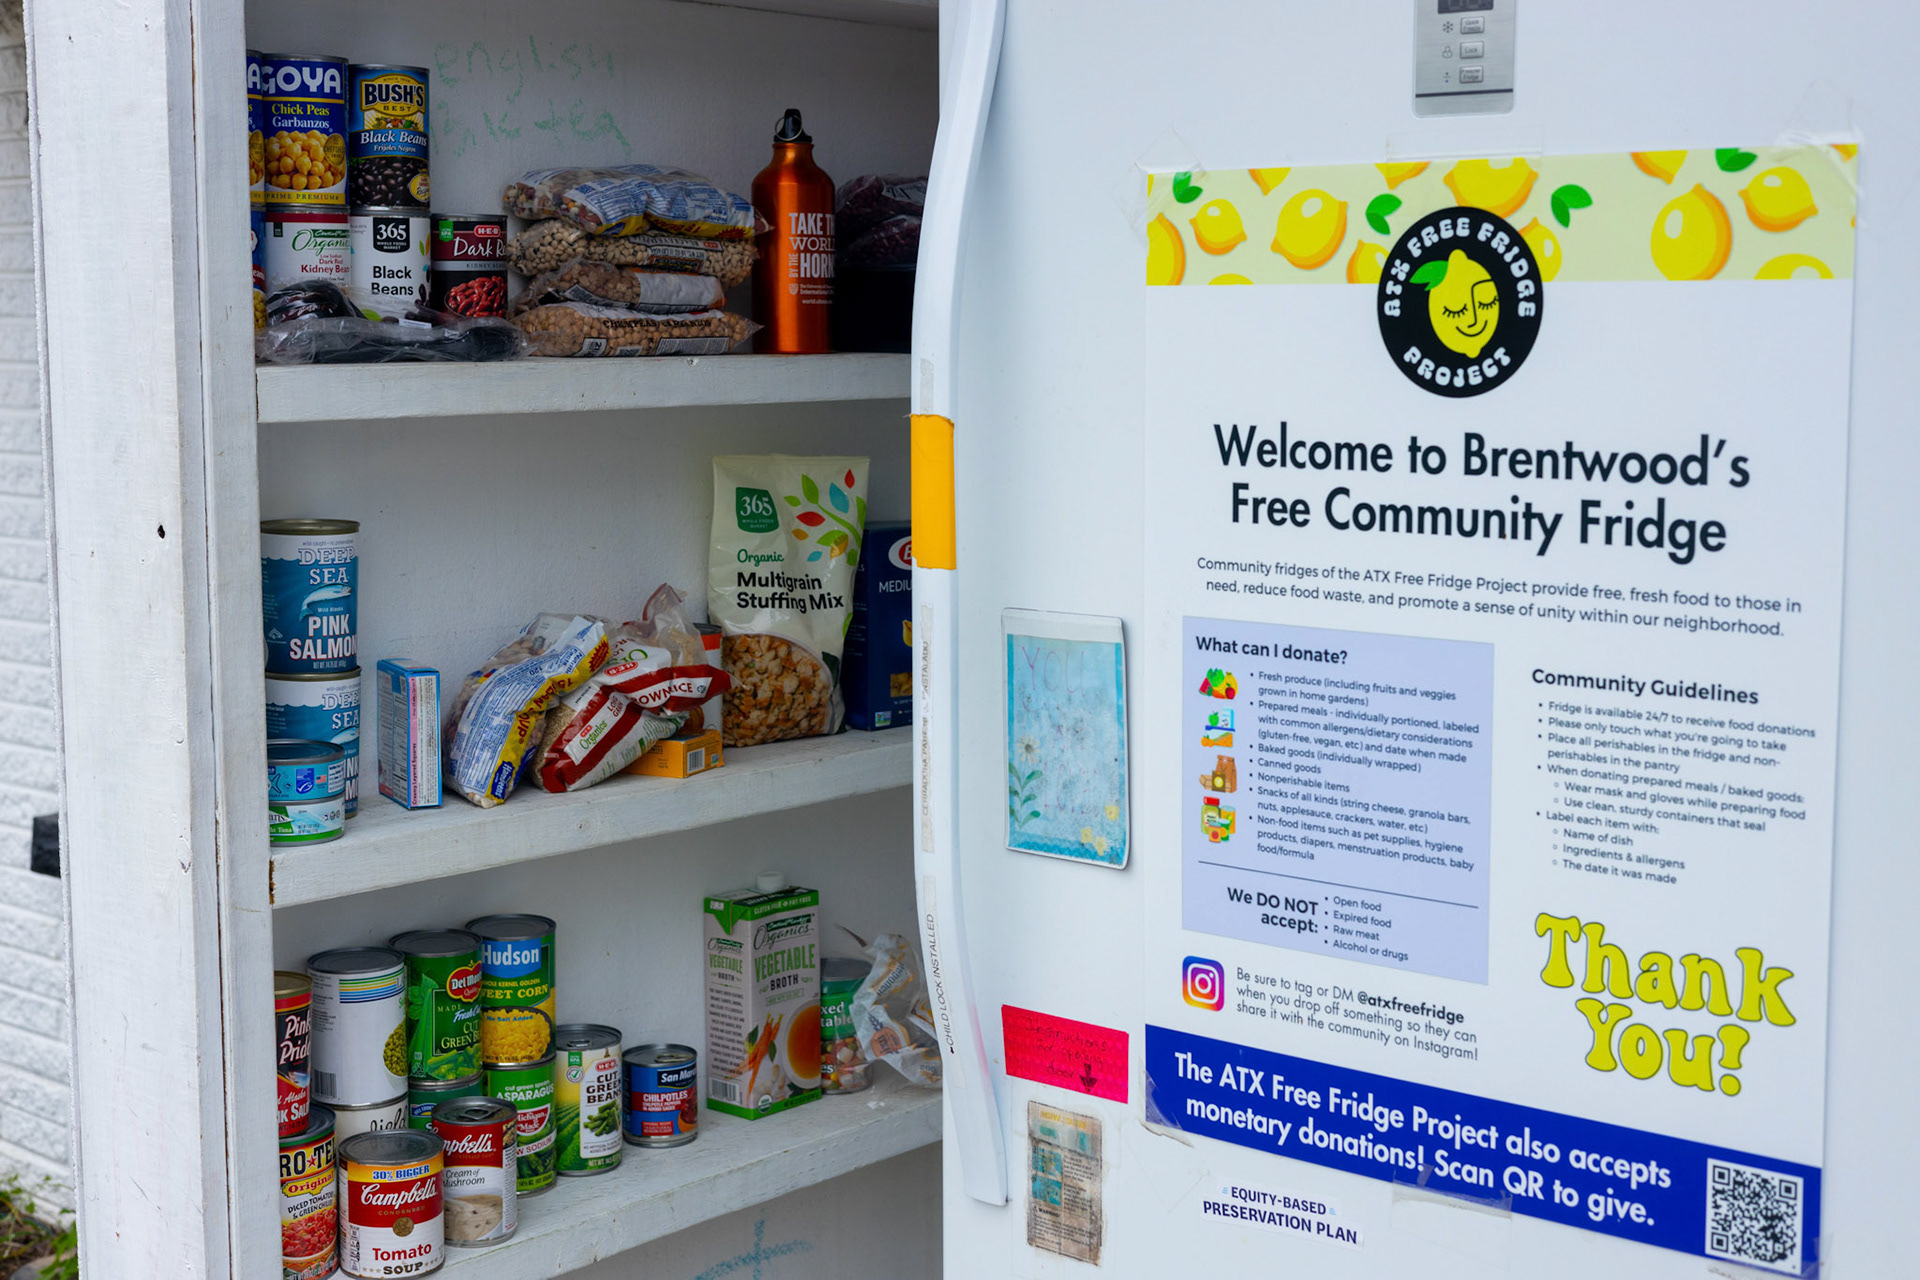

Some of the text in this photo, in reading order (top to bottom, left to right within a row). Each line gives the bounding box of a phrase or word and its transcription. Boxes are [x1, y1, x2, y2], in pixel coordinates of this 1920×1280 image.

[261, 65, 341, 94] GOYA
[364, 83, 424, 107] BUSH'S
[272, 103, 330, 116] Chick Peas
[272, 116, 330, 129] Garbanzos
[361, 131, 428, 147] Black Beans
[373, 144, 417, 153] Frijoles Negros
[376, 222, 407, 241] 365
[788, 212, 823, 235] TAKE
[453, 236, 493, 257] Dark
[301, 264, 334, 275] Kidney
[373, 265, 412, 279] Black
[788, 253, 799, 278] BY THE
[371, 282, 414, 296] Beans
[1383, 216, 1537, 388] ATX FREE FRIDGE PROJECT
[1213, 420, 1750, 489] Welcome to Brentwood's
[740, 494, 773, 517] 365
[1232, 481, 1727, 566] Free Community Fridge
[298, 546, 355, 566] DEEP
[737, 548, 785, 567] Organic
[309, 567, 349, 585] SEA
[737, 571, 823, 593] Multigrain
[1196, 556, 1802, 613] Community fridges of the ATX Free Fridge Project provide free, fresh food to those in
[736, 591, 845, 614] Stuffing Mix
[1206, 579, 1784, 637] need, reduce food waste, and promote a sense of unity within our neighborhood.
[308, 613, 350, 637] PINK
[1195, 635, 1348, 665] What can I donate?
[1022, 645, 1085, 697] YOU
[1531, 668, 1759, 705] Community Guidelines
[1548, 700, 1816, 739] Fridge is available 24/7 to receive food donations
[579, 719, 608, 750] Organics
[1257, 757, 1322, 775] Canned goods
[1257, 771, 1351, 793] Nonperishable items
[1562, 843, 1686, 870] Ingredients & allergens
[1227, 886, 1319, 916] We DO NOT
[1260, 912, 1318, 935] accept:
[753, 924, 814, 951] Organics
[481, 944, 539, 966] Hudson
[709, 953, 743, 975] VEGETABLE
[754, 944, 816, 983] VEGETABLE
[718, 972, 735, 982] BROTH
[927, 914, 955, 1046] CHILD LOCK INSTALLED
[1534, 912, 1798, 1027] Thank
[498, 977, 541, 988] KERNEL GOLDEN
[517, 984, 548, 998] CORN
[770, 973, 799, 991] BROTH
[463, 1020, 480, 1033] CUT
[512, 1014, 534, 1022] Added
[441, 1034, 472, 1049] GREEN
[1574, 996, 1751, 1097] You!
[596, 1070, 618, 1084] CUT
[661, 1072, 679, 1084] San
[496, 1083, 554, 1102] ASPARAGUS
[1174, 1051, 1672, 1191] The ATX Free Fridge Project also accepts
[526, 1136, 553, 1156] SODIUM
[373, 1164, 430, 1180] 30% BIGGER
[1186, 1097, 1655, 1227] monetary donations! Scan QR to give.
[288, 1171, 334, 1193] Original
[446, 1168, 480, 1179] Cream of
[361, 1177, 437, 1210] Campbell's
[1231, 1186, 1327, 1216] EQUITY-BASED
[1203, 1200, 1357, 1245] PRESERVATION PLAN
[372, 1242, 432, 1262] Tomato
[383, 1261, 424, 1276] SOUP
